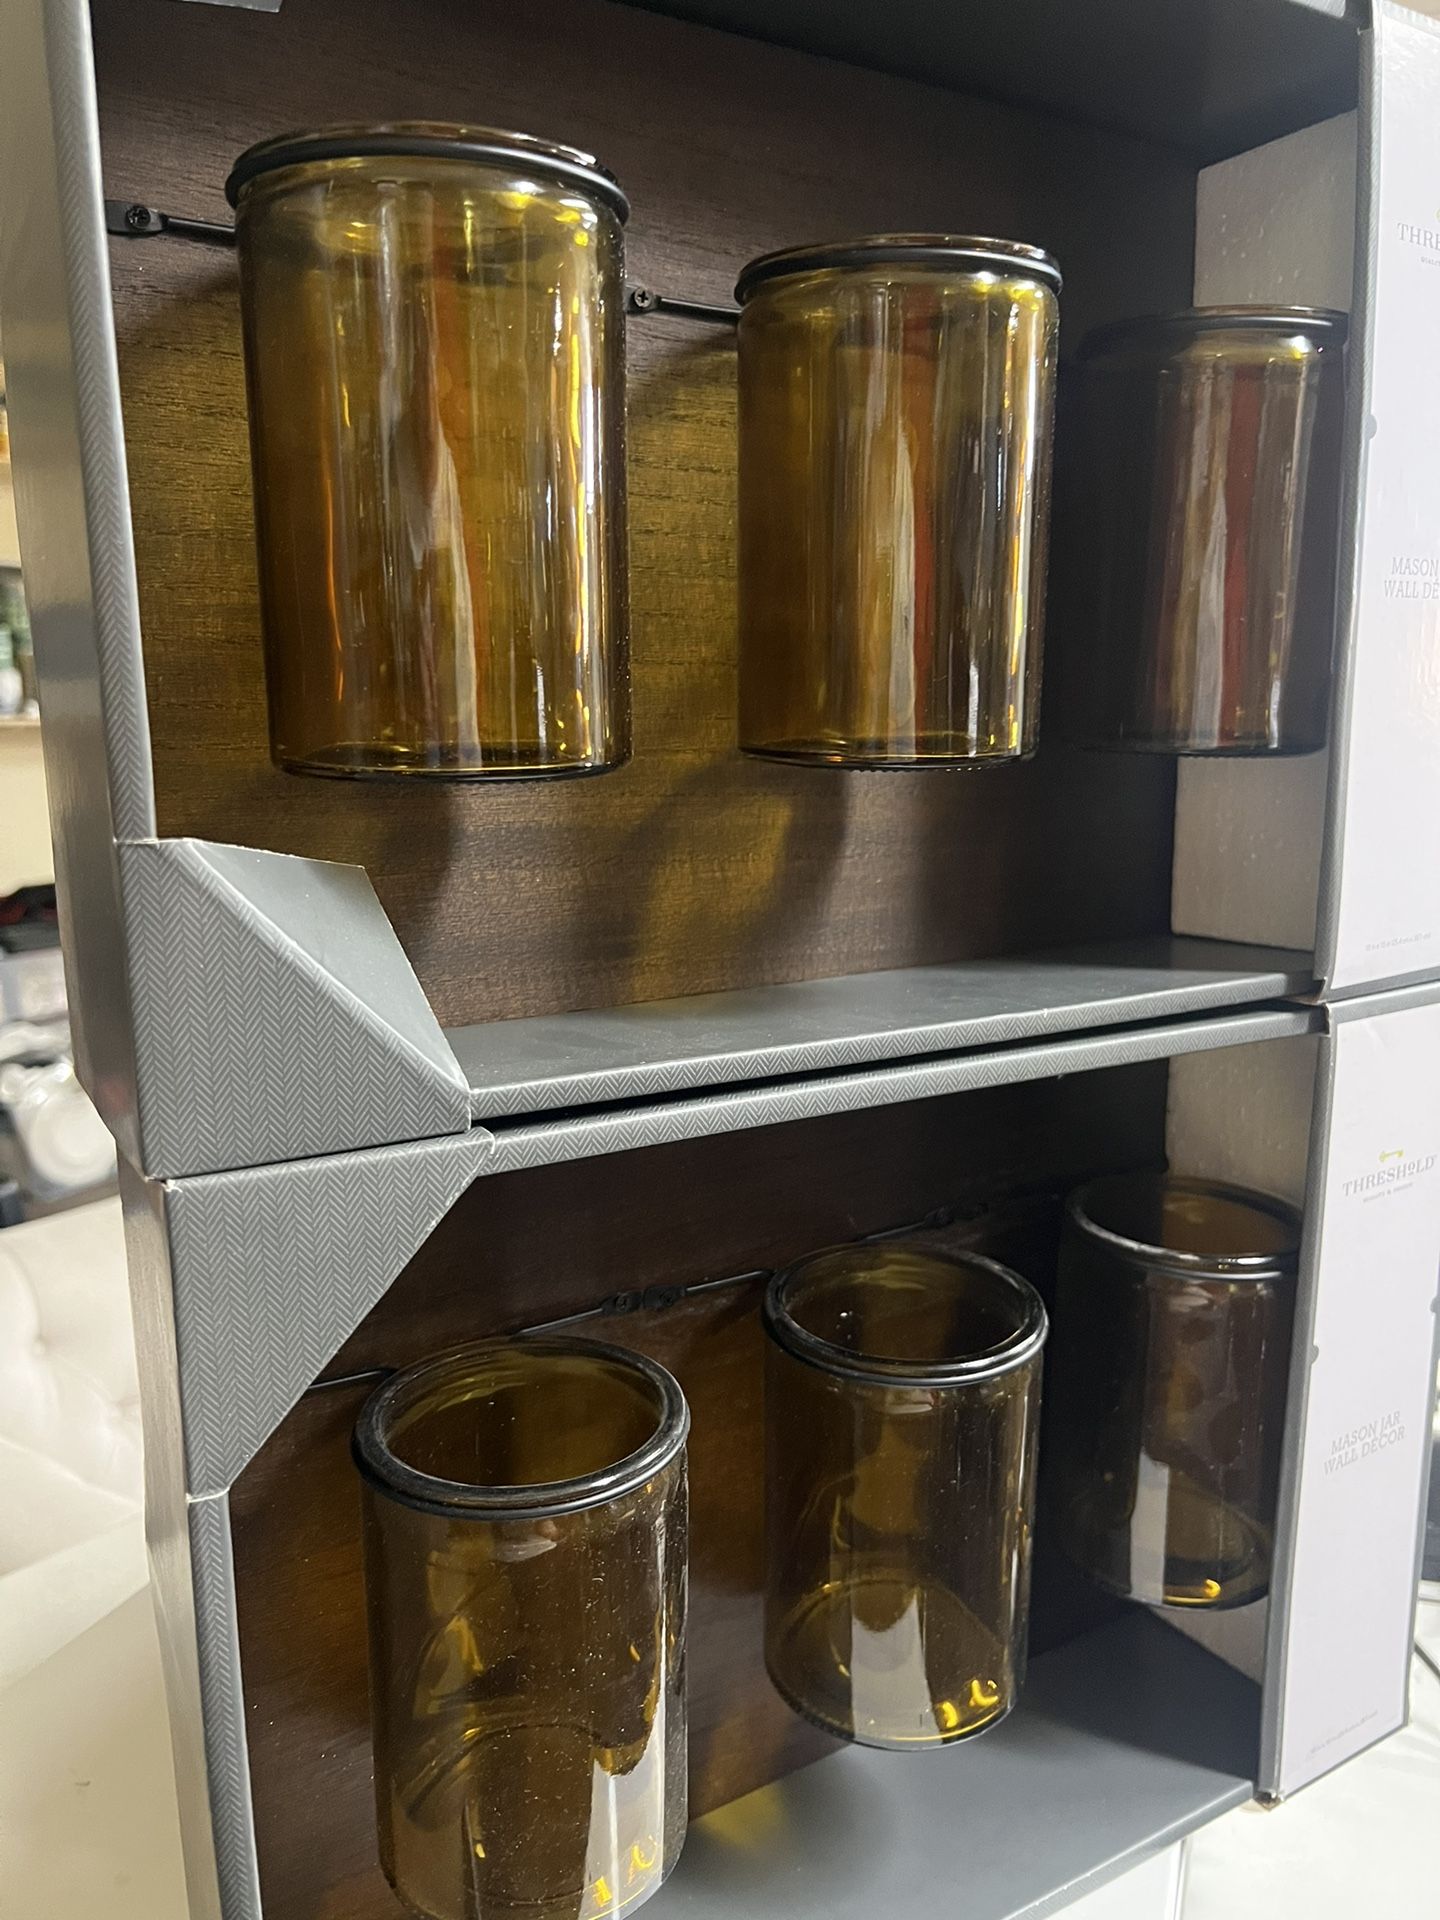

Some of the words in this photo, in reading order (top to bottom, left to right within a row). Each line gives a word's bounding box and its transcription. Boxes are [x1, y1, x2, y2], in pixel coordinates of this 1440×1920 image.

[1391, 556, 1439, 577] MASON
[1384, 579, 1419, 599] WALL
[1331, 1420, 1378, 1455] MASON
[1379, 1410, 1400, 1436] JAR
[1323, 1448, 1359, 1475] WALL
